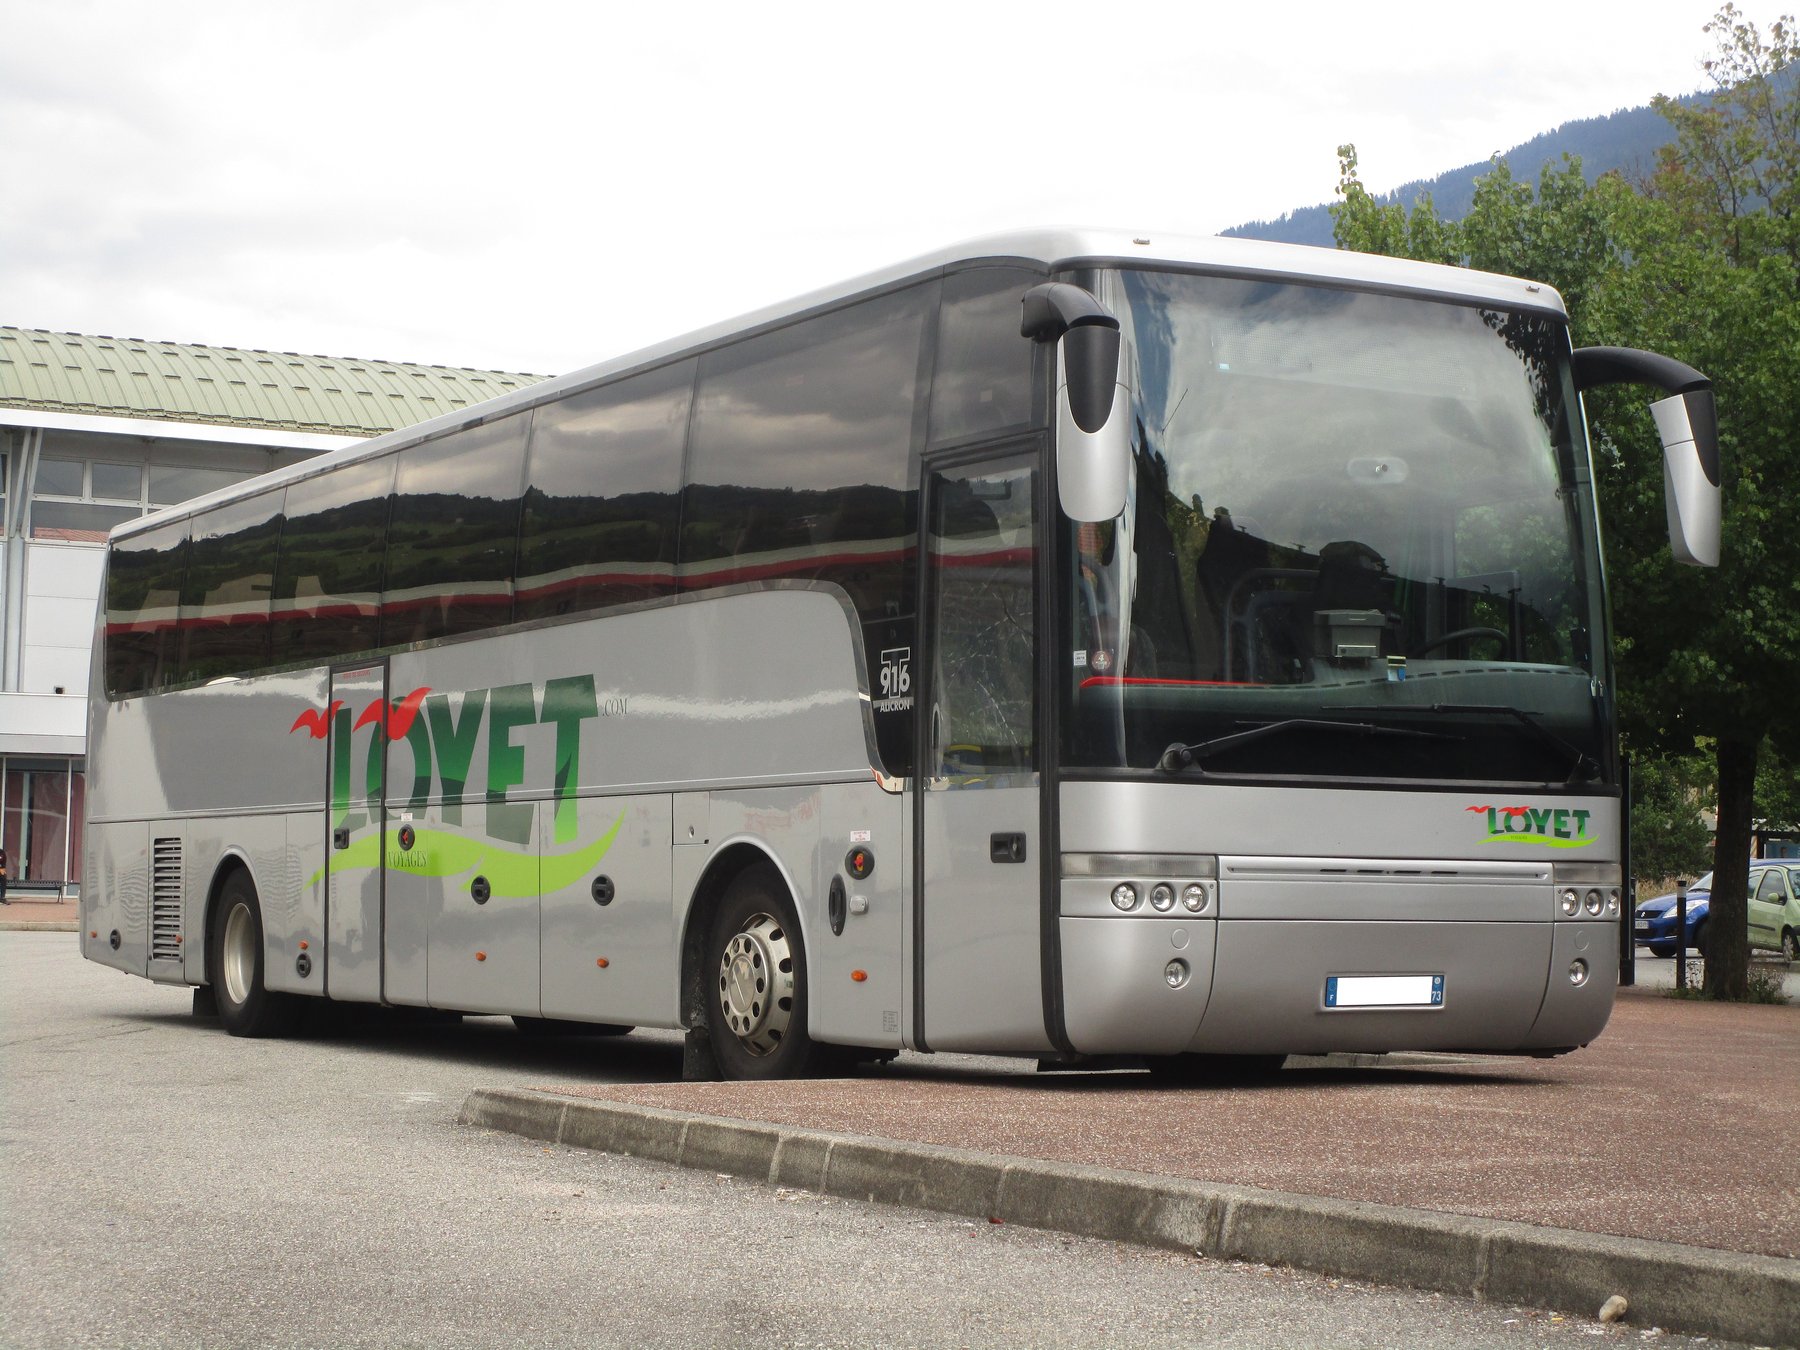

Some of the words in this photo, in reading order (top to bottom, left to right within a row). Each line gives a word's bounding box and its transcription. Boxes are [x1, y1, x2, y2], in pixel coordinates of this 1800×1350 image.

[880, 665, 910, 694] 916
[333, 673, 598, 845] LOYET
[1487, 807, 1591, 839] LOYET
[388, 850, 428, 868] VOYAGES
[1431, 990, 1442, 1002] 73
